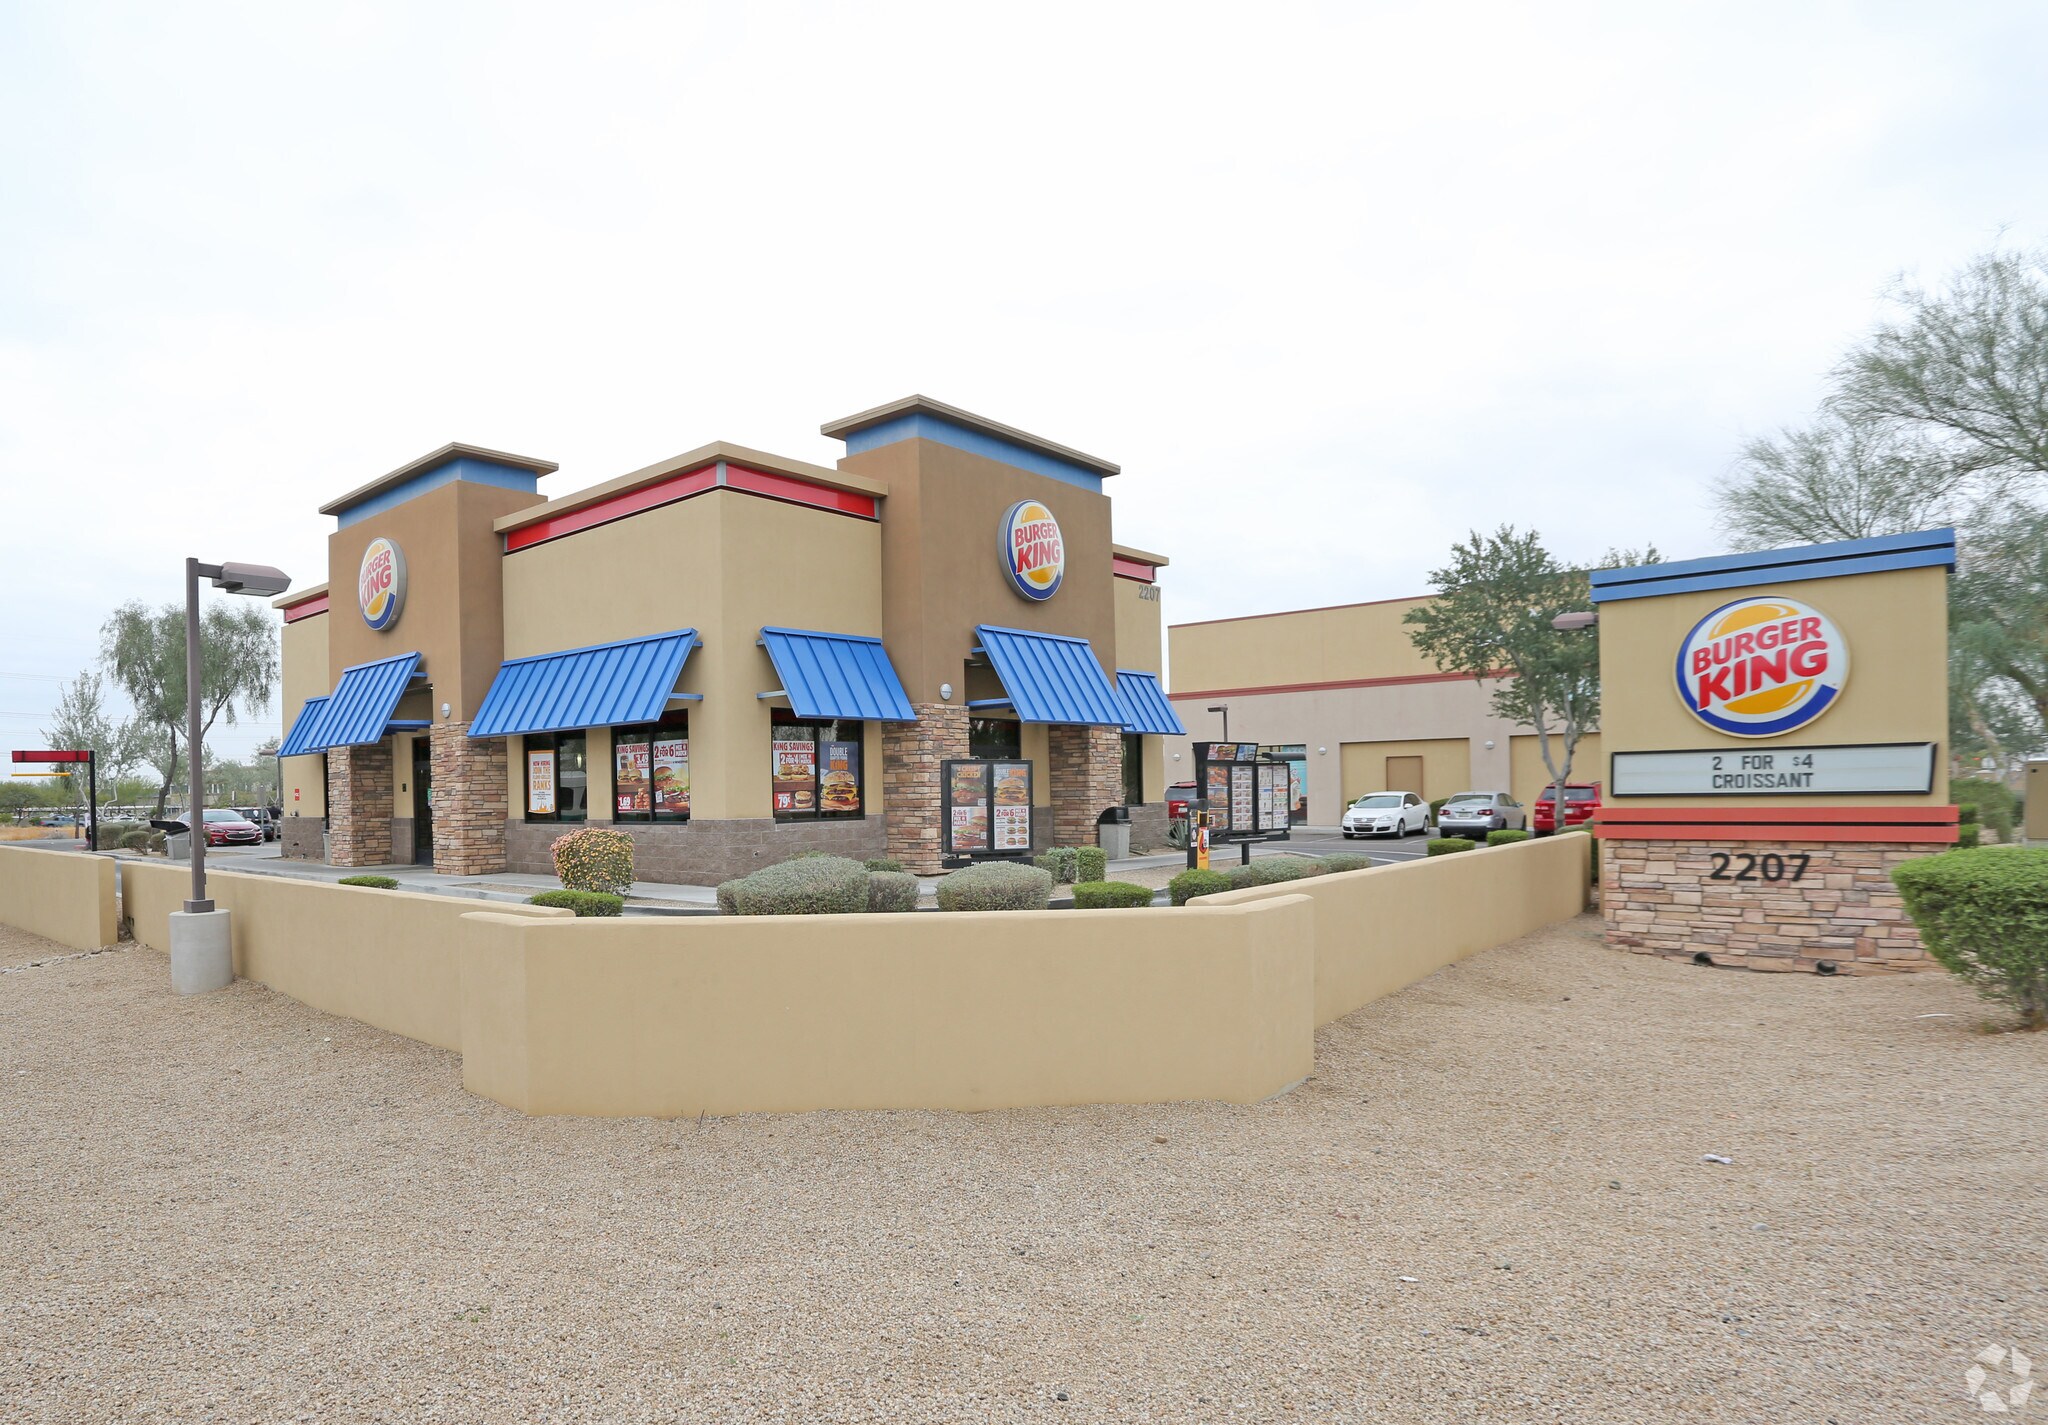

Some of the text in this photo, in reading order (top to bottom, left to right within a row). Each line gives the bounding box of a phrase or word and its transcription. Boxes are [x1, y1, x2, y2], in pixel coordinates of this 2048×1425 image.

[1015, 523, 1059, 547] BURGER
[1017, 539, 1060, 574] KING
[361, 550, 391, 584] BURGER
[361, 565, 392, 614] KING
[1138, 584, 1160, 602] 2207
[1693, 616, 1822, 675] BURGER
[1698, 640, 1828, 710] KING
[629, 744, 649, 753] SAVINGS
[654, 746, 659, 758] 2
[660, 749, 668, 757] FOR
[773, 742, 814, 751] KING SAVINGS
[829, 747, 848, 756] DOUBLE
[780, 754, 785, 764] 2
[829, 760, 848, 770] KING
[1712, 756, 1722, 770] 2
[1742, 755, 1773, 770] FOR
[1713, 773, 1814, 789] CROISSANT
[996, 809, 1001, 817] 2
[1710, 852, 1810, 881] 2207
